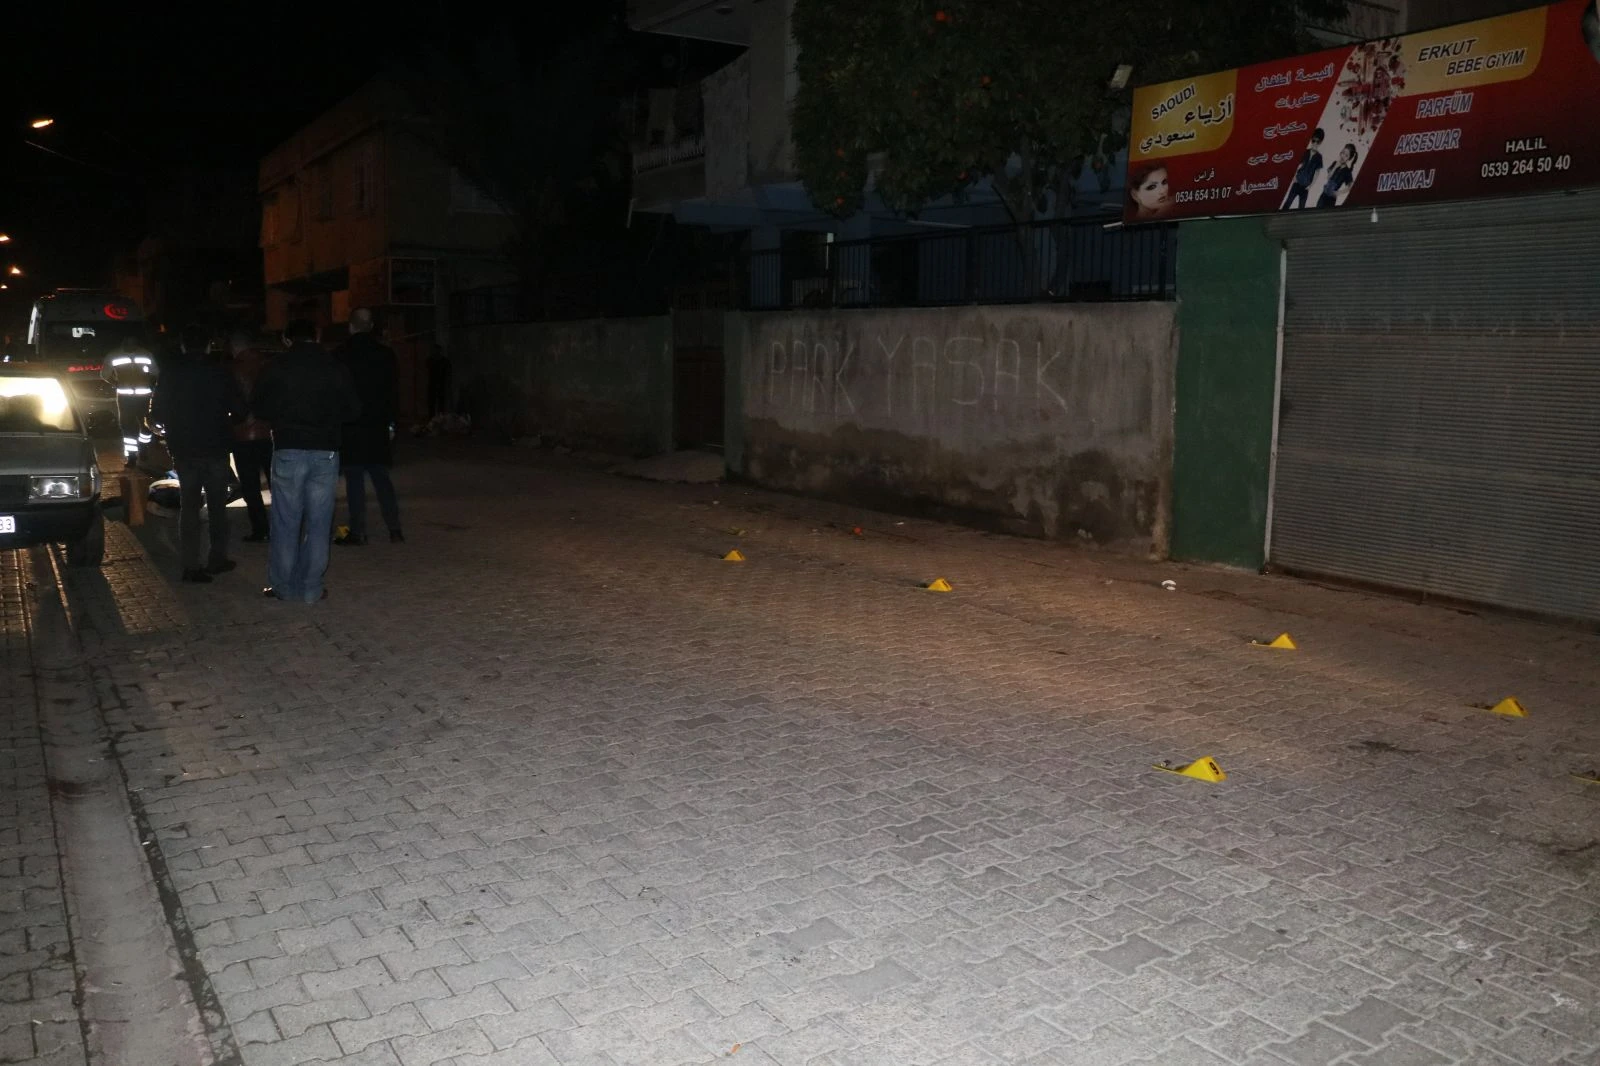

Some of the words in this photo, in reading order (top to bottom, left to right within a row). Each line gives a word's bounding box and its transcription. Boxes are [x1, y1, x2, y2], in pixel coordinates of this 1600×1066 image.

[1418, 38, 1477, 62] ERKUT
[1446, 56, 1483, 76] BEBE
[1416, 91, 1474, 119] PARFÜM
[1394, 128, 1462, 155] AKSESUAR
[1481, 162, 1509, 178] 0539
[1511, 159, 1534, 175] 264
[1536, 156, 1552, 172] 50
[1554, 154, 1571, 170] 40
[1376, 168, 1436, 193] MAKYAJ
[1175, 190, 1193, 203] 0534
[1194, 188, 1209, 201] 654
[1221, 186, 1232, 199] 07
[876, 335, 1069, 416] YASAK
